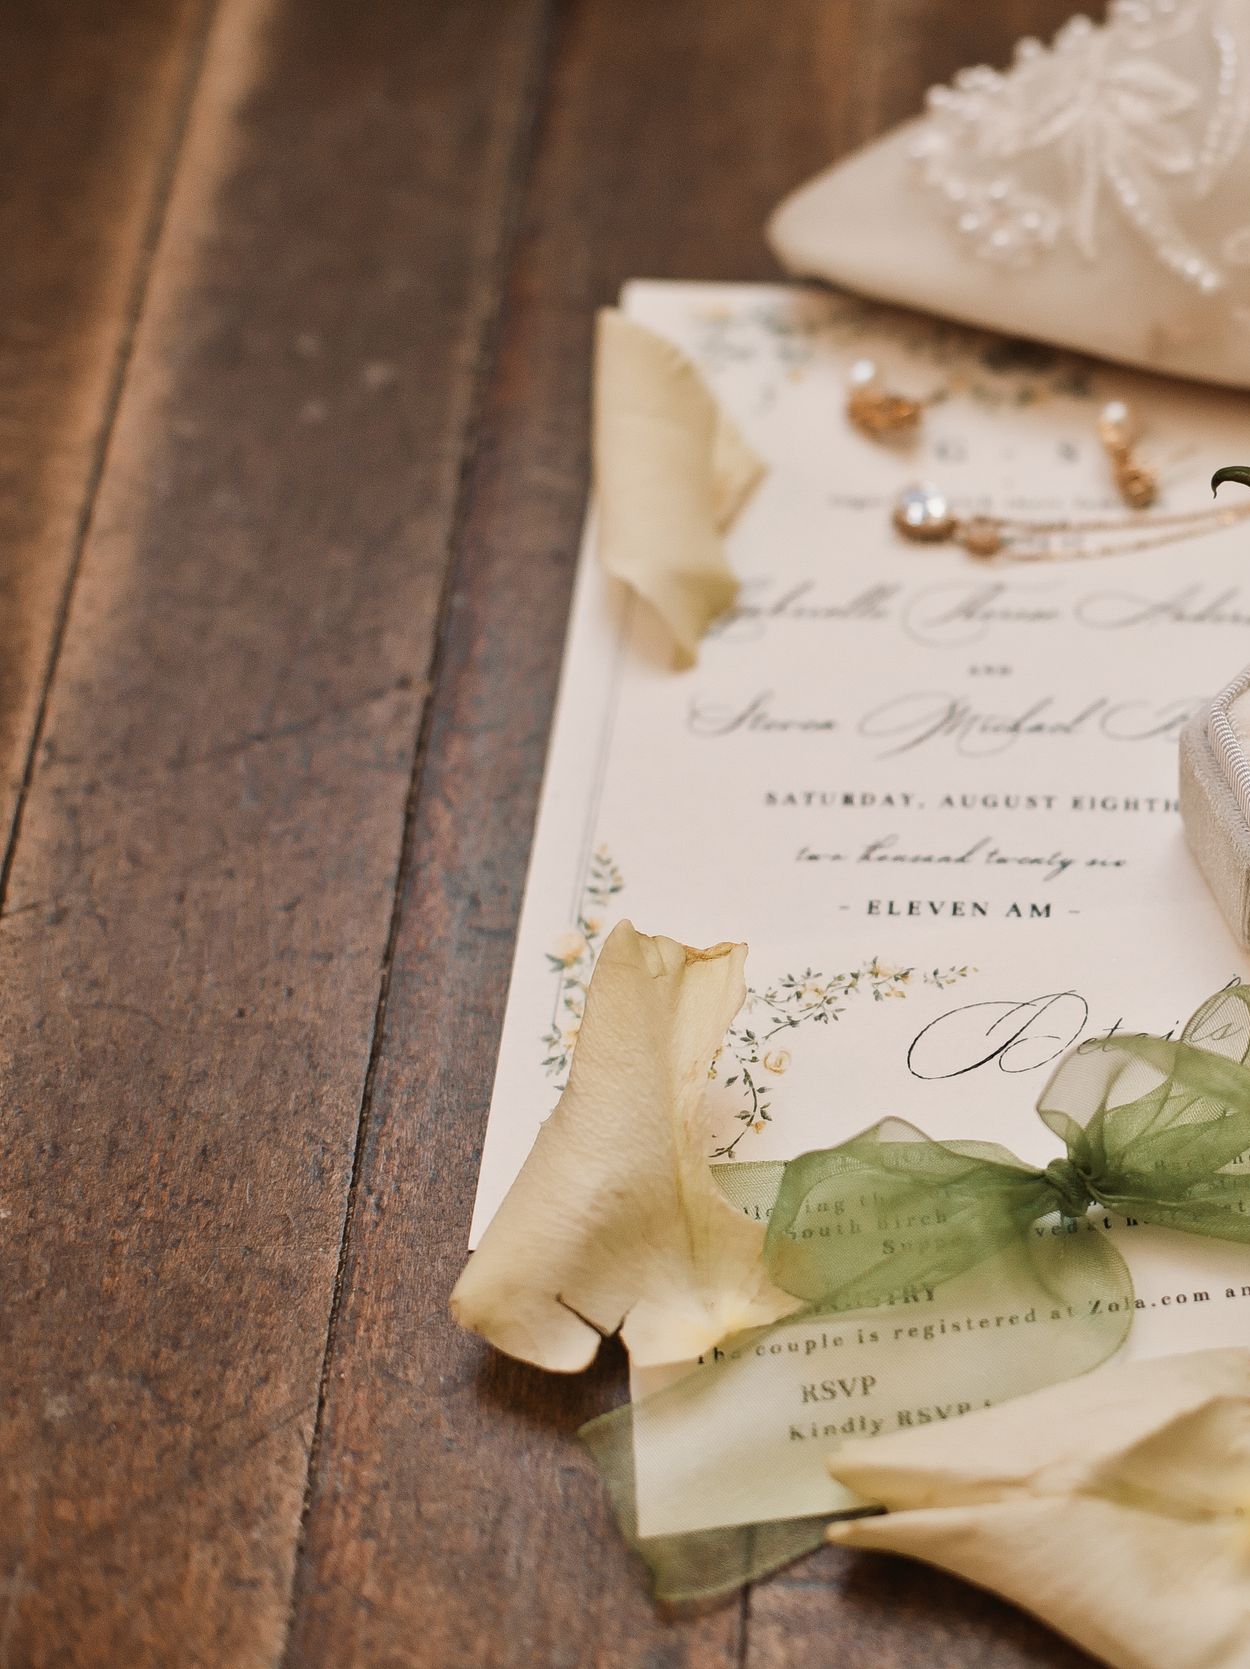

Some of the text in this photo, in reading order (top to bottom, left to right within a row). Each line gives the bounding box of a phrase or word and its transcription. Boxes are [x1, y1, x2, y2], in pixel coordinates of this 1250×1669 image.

[968, 664, 1013, 677] AND
[857, 691, 1108, 761] Michael
[765, 791, 926, 809] SATURDAY,
[940, 794, 1057, 810] AUGUST
[796, 847, 849, 862] two
[855, 833, 993, 863] thousand
[985, 849, 1076, 882] twenty
[866, 899, 1052, 919] ELEVEN AM
[755, 1332, 844, 1360] couple
[857, 1328, 880, 1345] is
[893, 1307, 1037, 1341] registered
[1050, 1305, 1075, 1321] at
[1088, 1290, 1210, 1317] Zola.com
[801, 1374, 876, 1403] RSVP
[789, 1401, 971, 1441] Kindly RSVP
